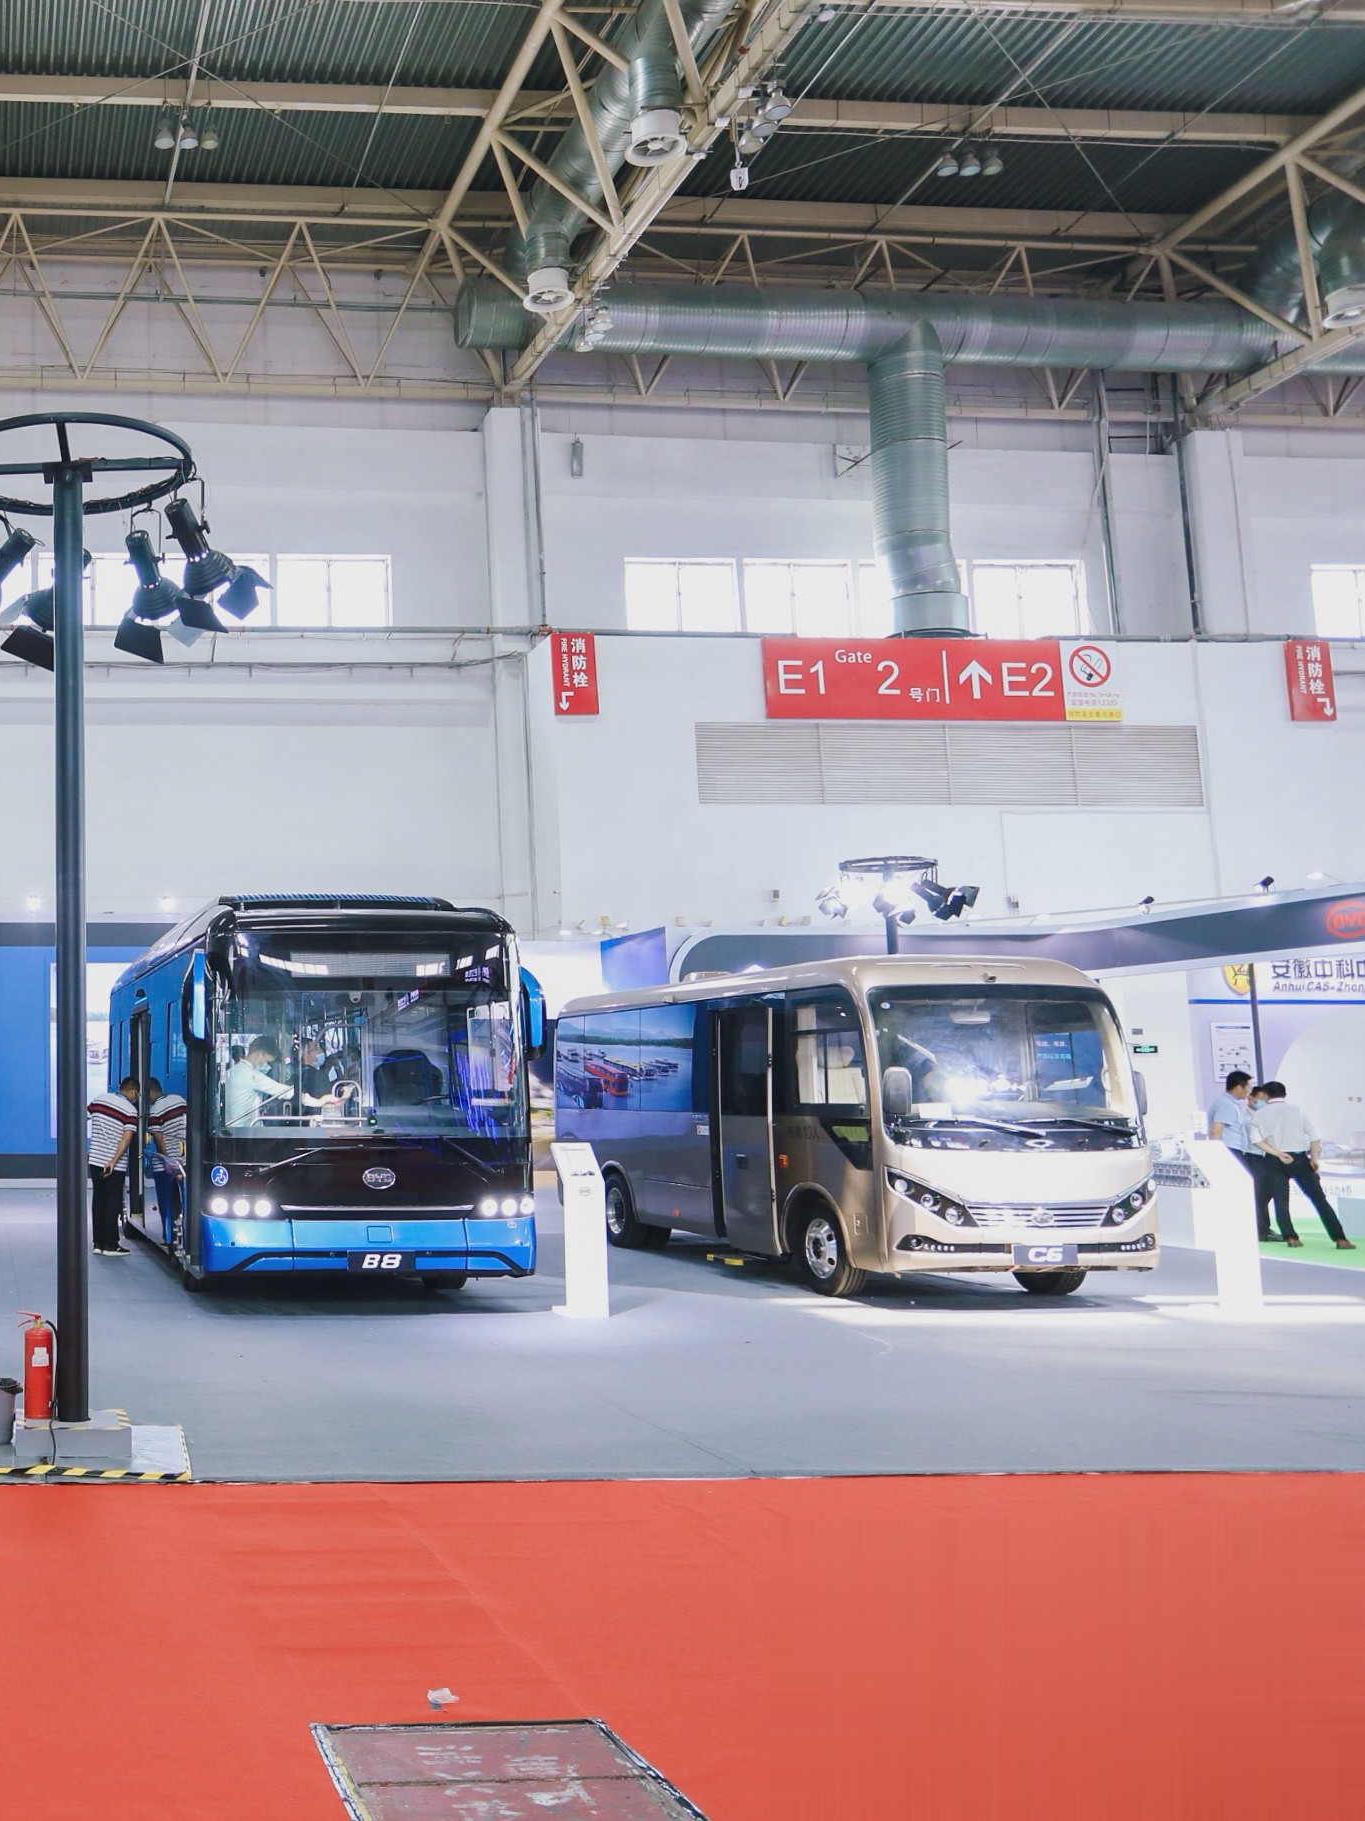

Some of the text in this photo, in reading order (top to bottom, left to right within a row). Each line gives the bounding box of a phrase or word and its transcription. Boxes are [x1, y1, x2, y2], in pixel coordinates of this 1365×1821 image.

[560, 637, 571, 687] FIRE HYDRANT
[570, 637, 589, 687] 消防栓
[835, 649, 872, 663] Gate
[1295, 645, 1307, 695] FIRE HYDRANT
[1305, 645, 1326, 695] 消防栓
[777, 659, 826, 695] E1
[1001, 662, 1055, 697] E2
[1273, 981, 1365, 993] Anhui CAS-Zhon
[362, 1253, 403, 1269] B8
[1027, 1246, 1064, 1263] C6
